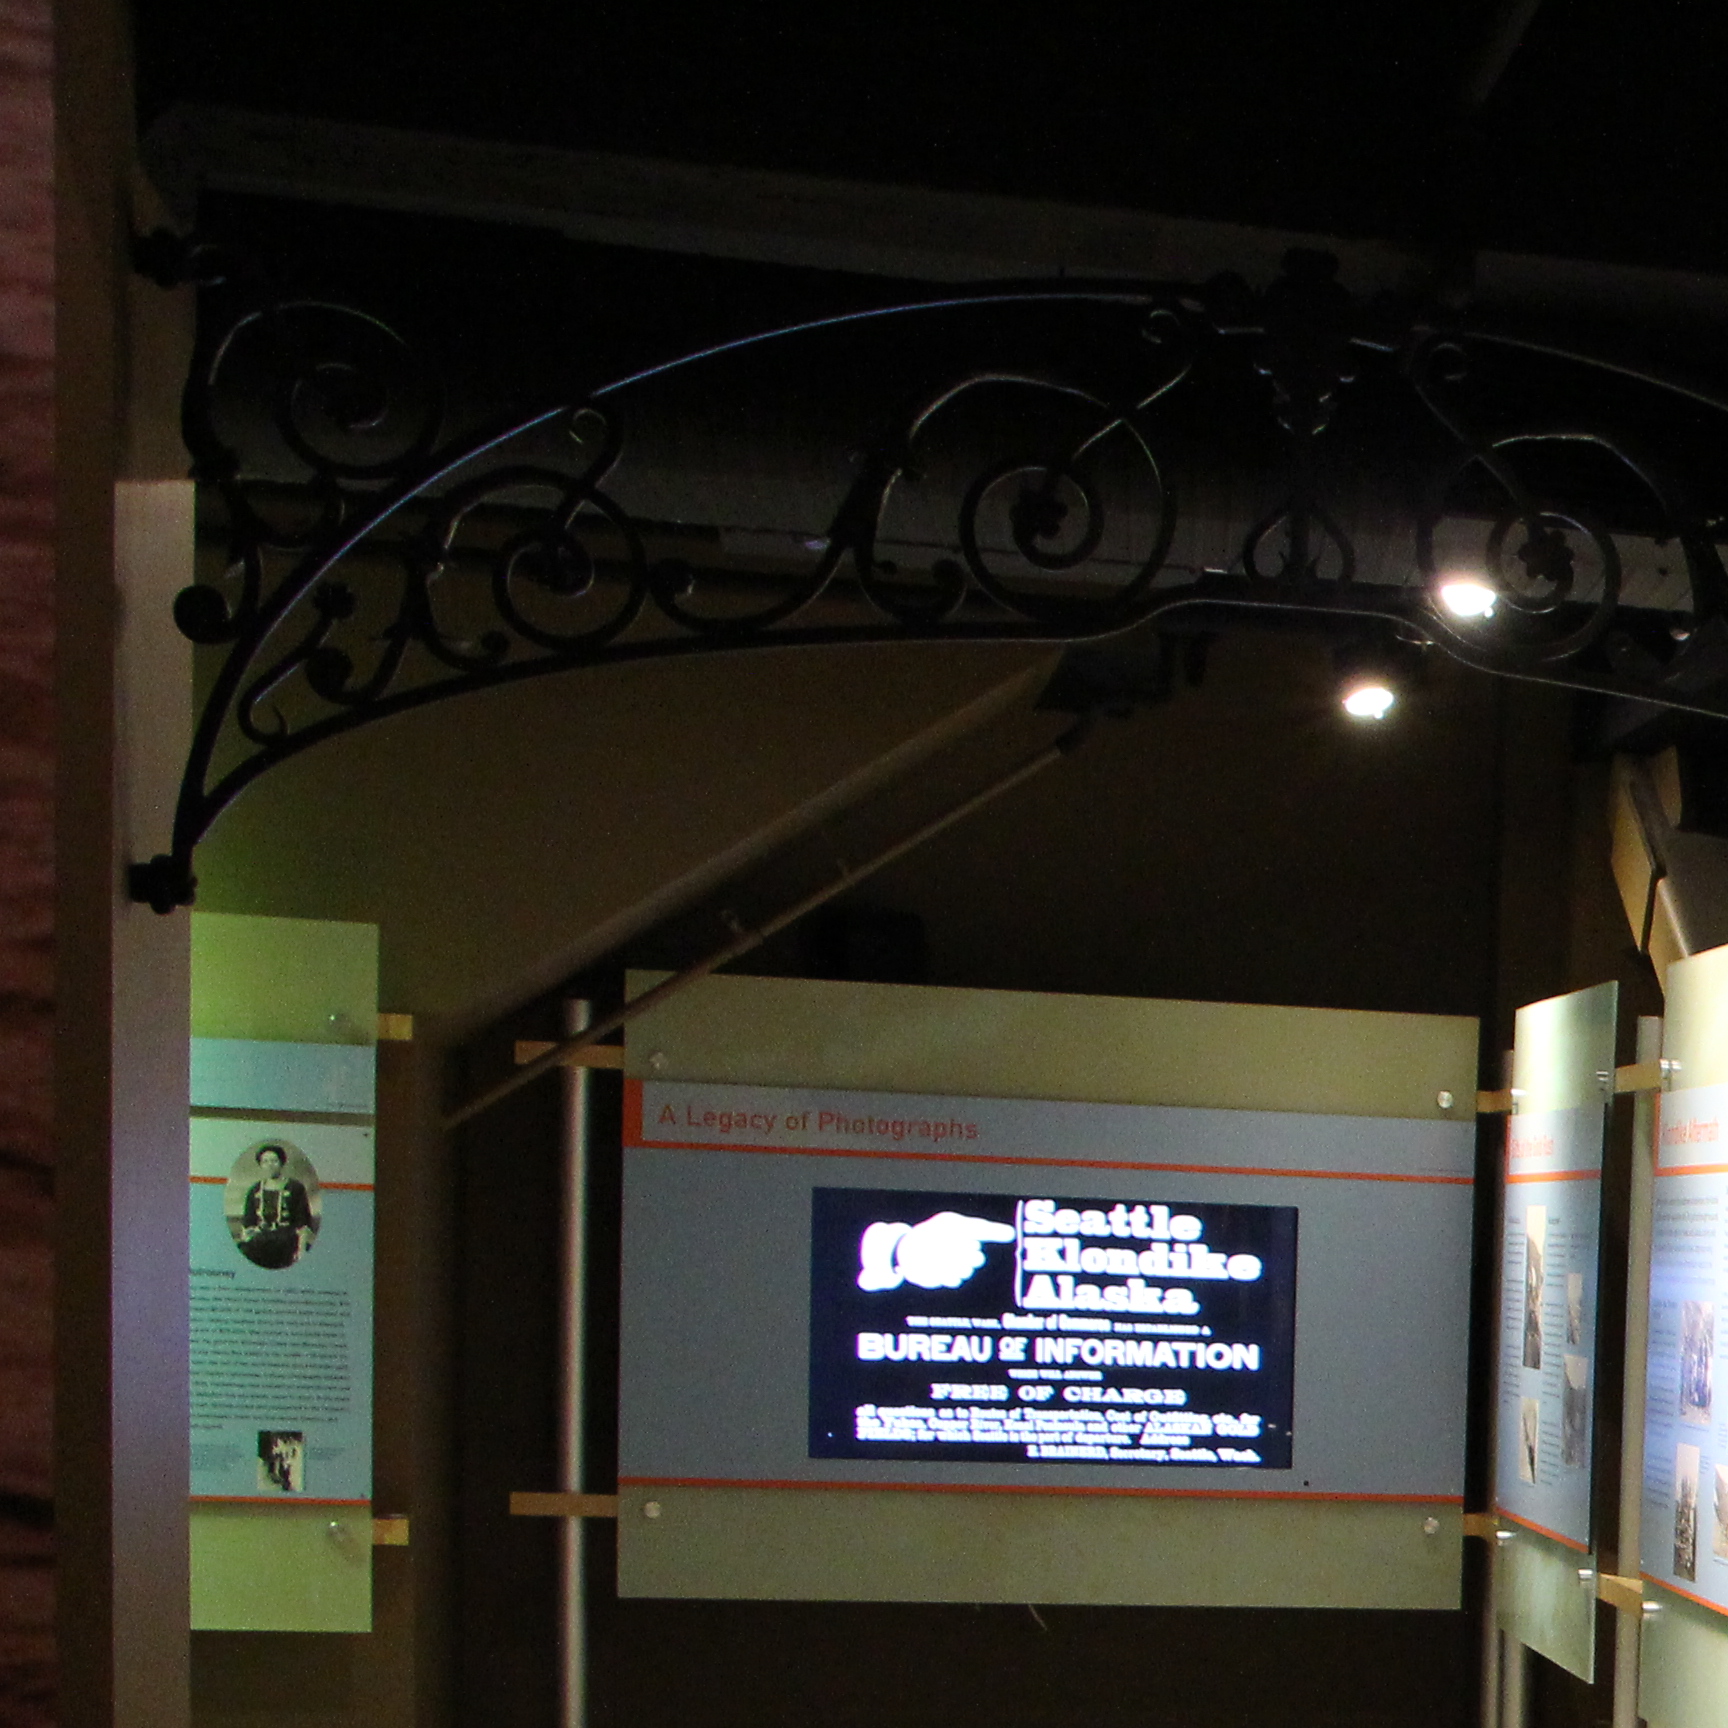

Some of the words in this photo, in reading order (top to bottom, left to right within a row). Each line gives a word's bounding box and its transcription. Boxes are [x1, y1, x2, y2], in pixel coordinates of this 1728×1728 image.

[658, 1104, 676, 1124] A
[686, 1105, 777, 1135] Legacy
[785, 1111, 809, 1131] of
[819, 1111, 980, 1141] Photographs
[1023, 1199, 1202, 1242] Seattle
[1023, 1237, 1261, 1282] Klondike
[1023, 1274, 1200, 1315] Alaska
[857, 1332, 992, 1363] BUREAU
[998, 1337, 1028, 1361] OF
[1035, 1337, 1260, 1371] INFORMATION
[930, 1383, 1009, 1401] FREE
[1018, 1385, 1055, 1402] OF
[1063, 1387, 1187, 1406] CHARGE
